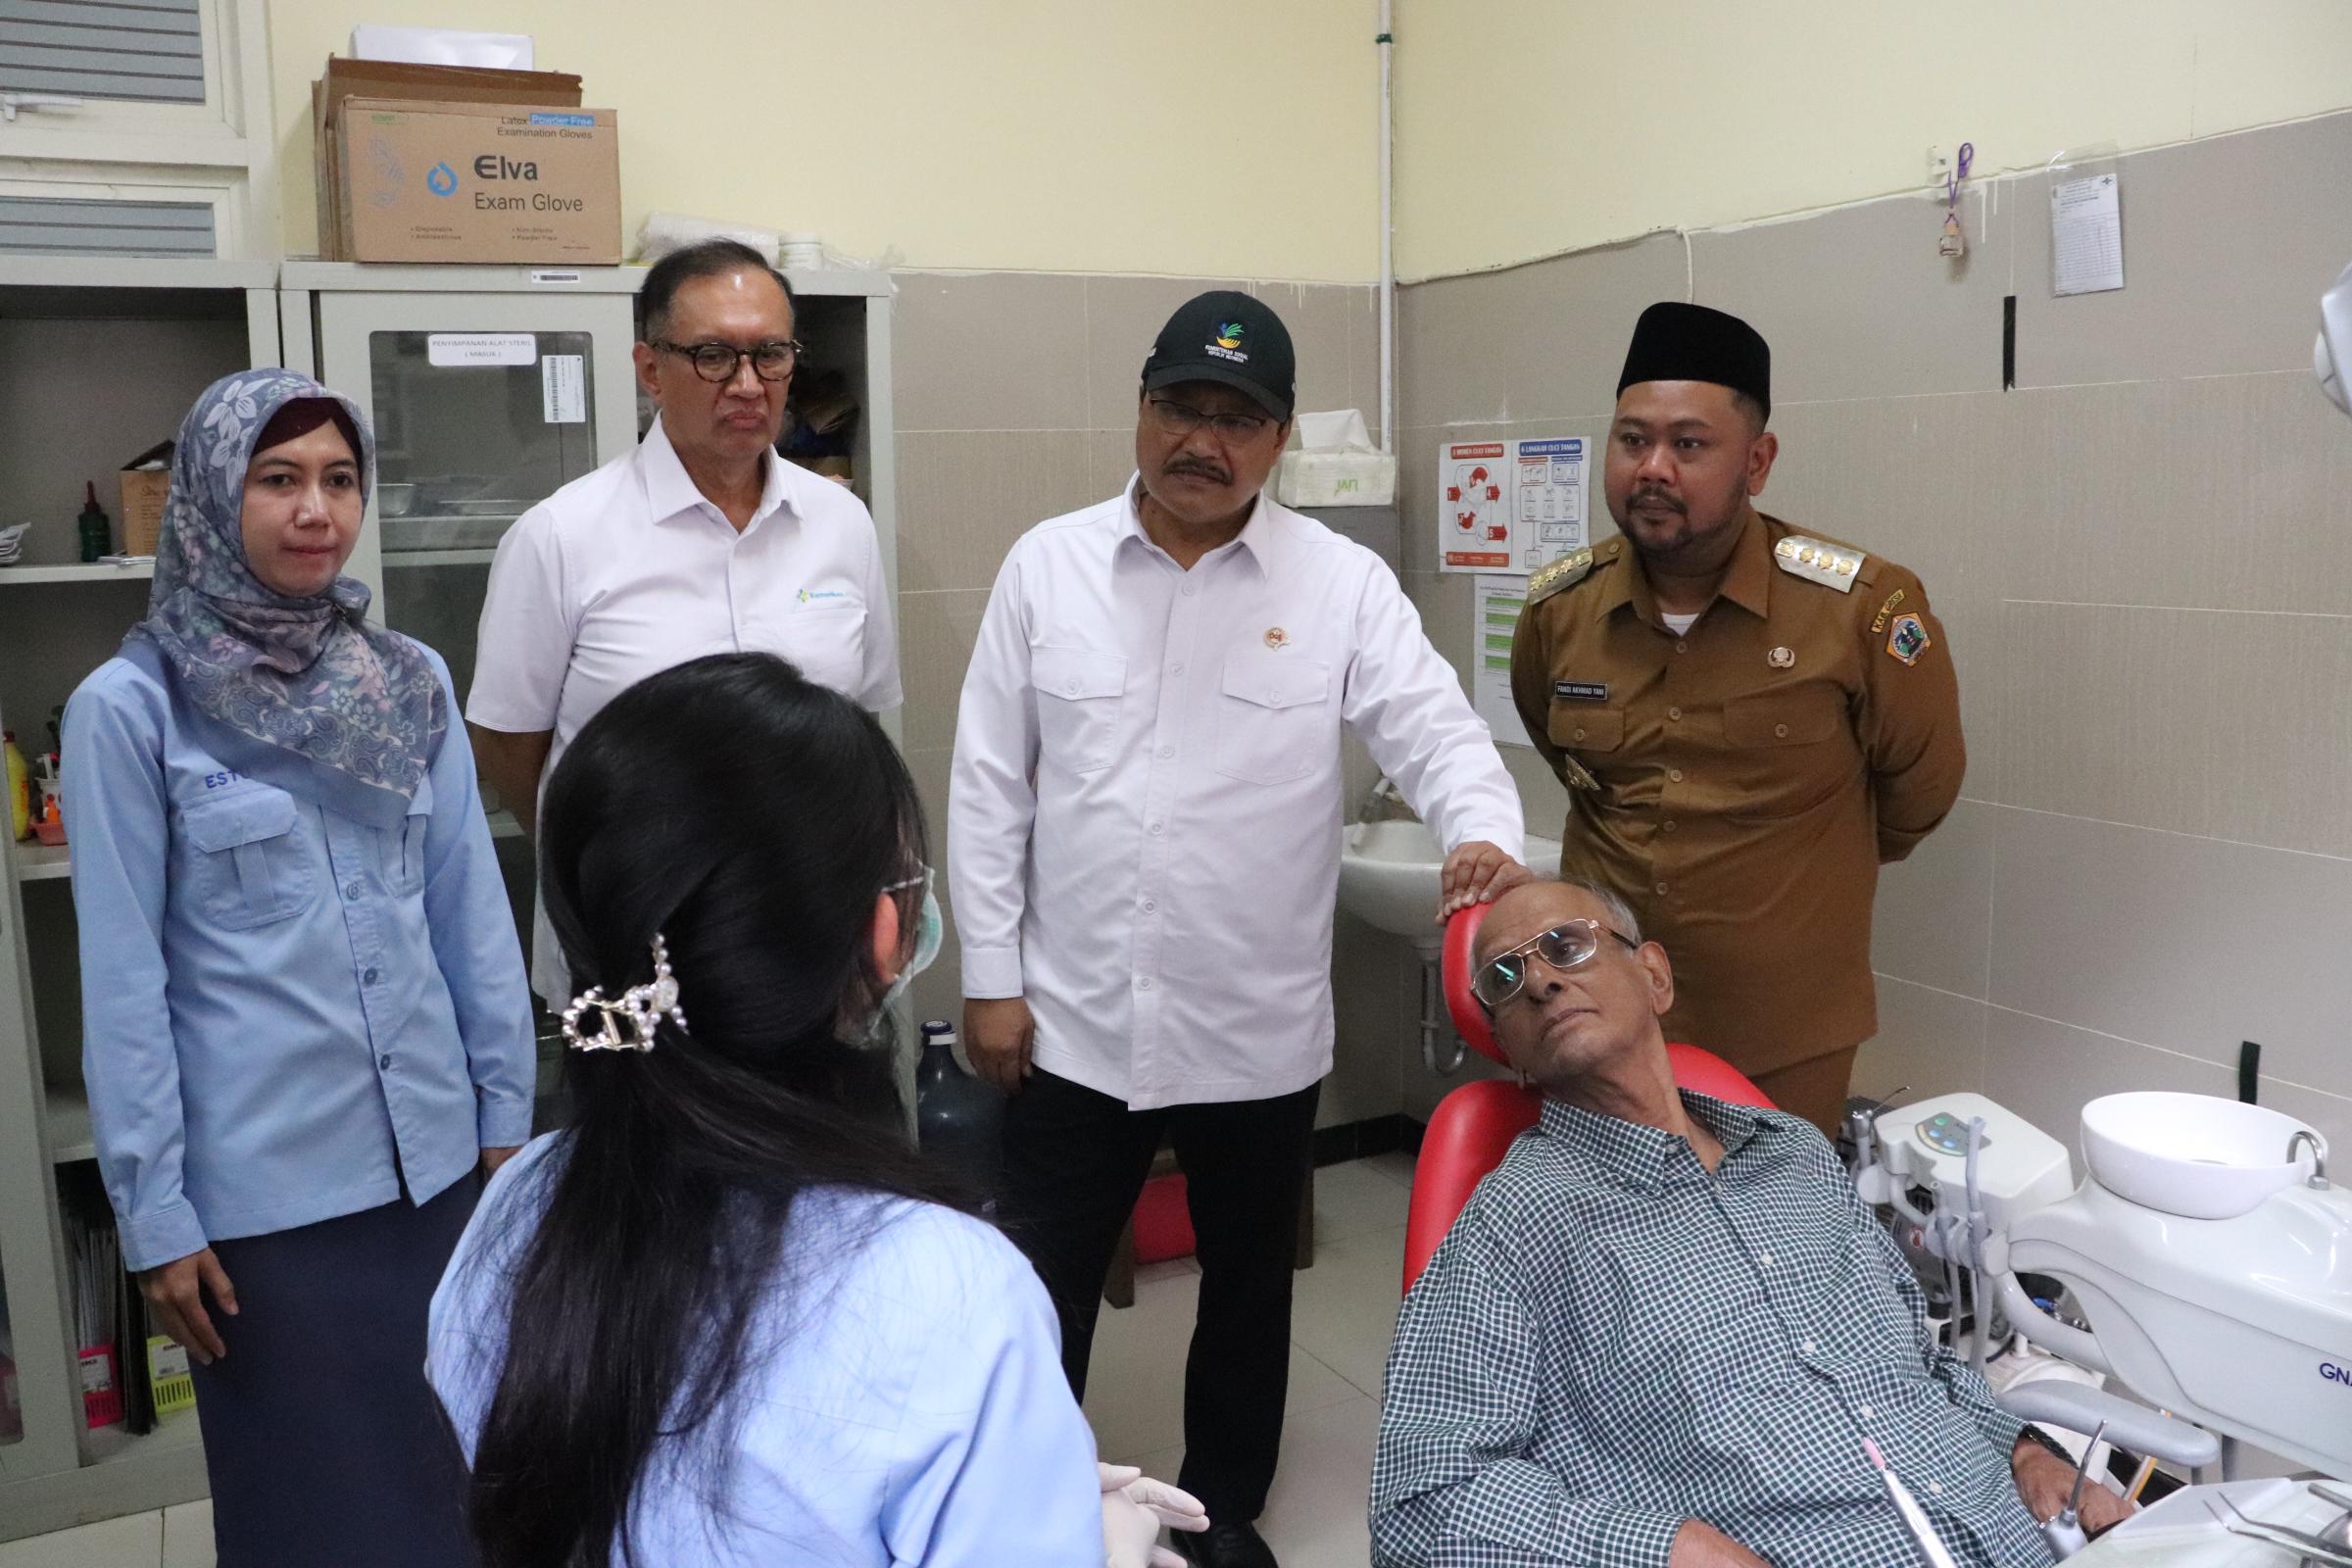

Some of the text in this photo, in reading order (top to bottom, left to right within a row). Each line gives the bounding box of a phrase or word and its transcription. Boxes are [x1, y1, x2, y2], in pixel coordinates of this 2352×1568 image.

[501, 115, 594, 126] Latex Powder Free
[497, 127, 593, 139] Examination Gloves
[473, 155, 538, 180] Elva
[474, 192, 583, 212] Exam Glove
[2319, 1362, 2352, 1387] GN
